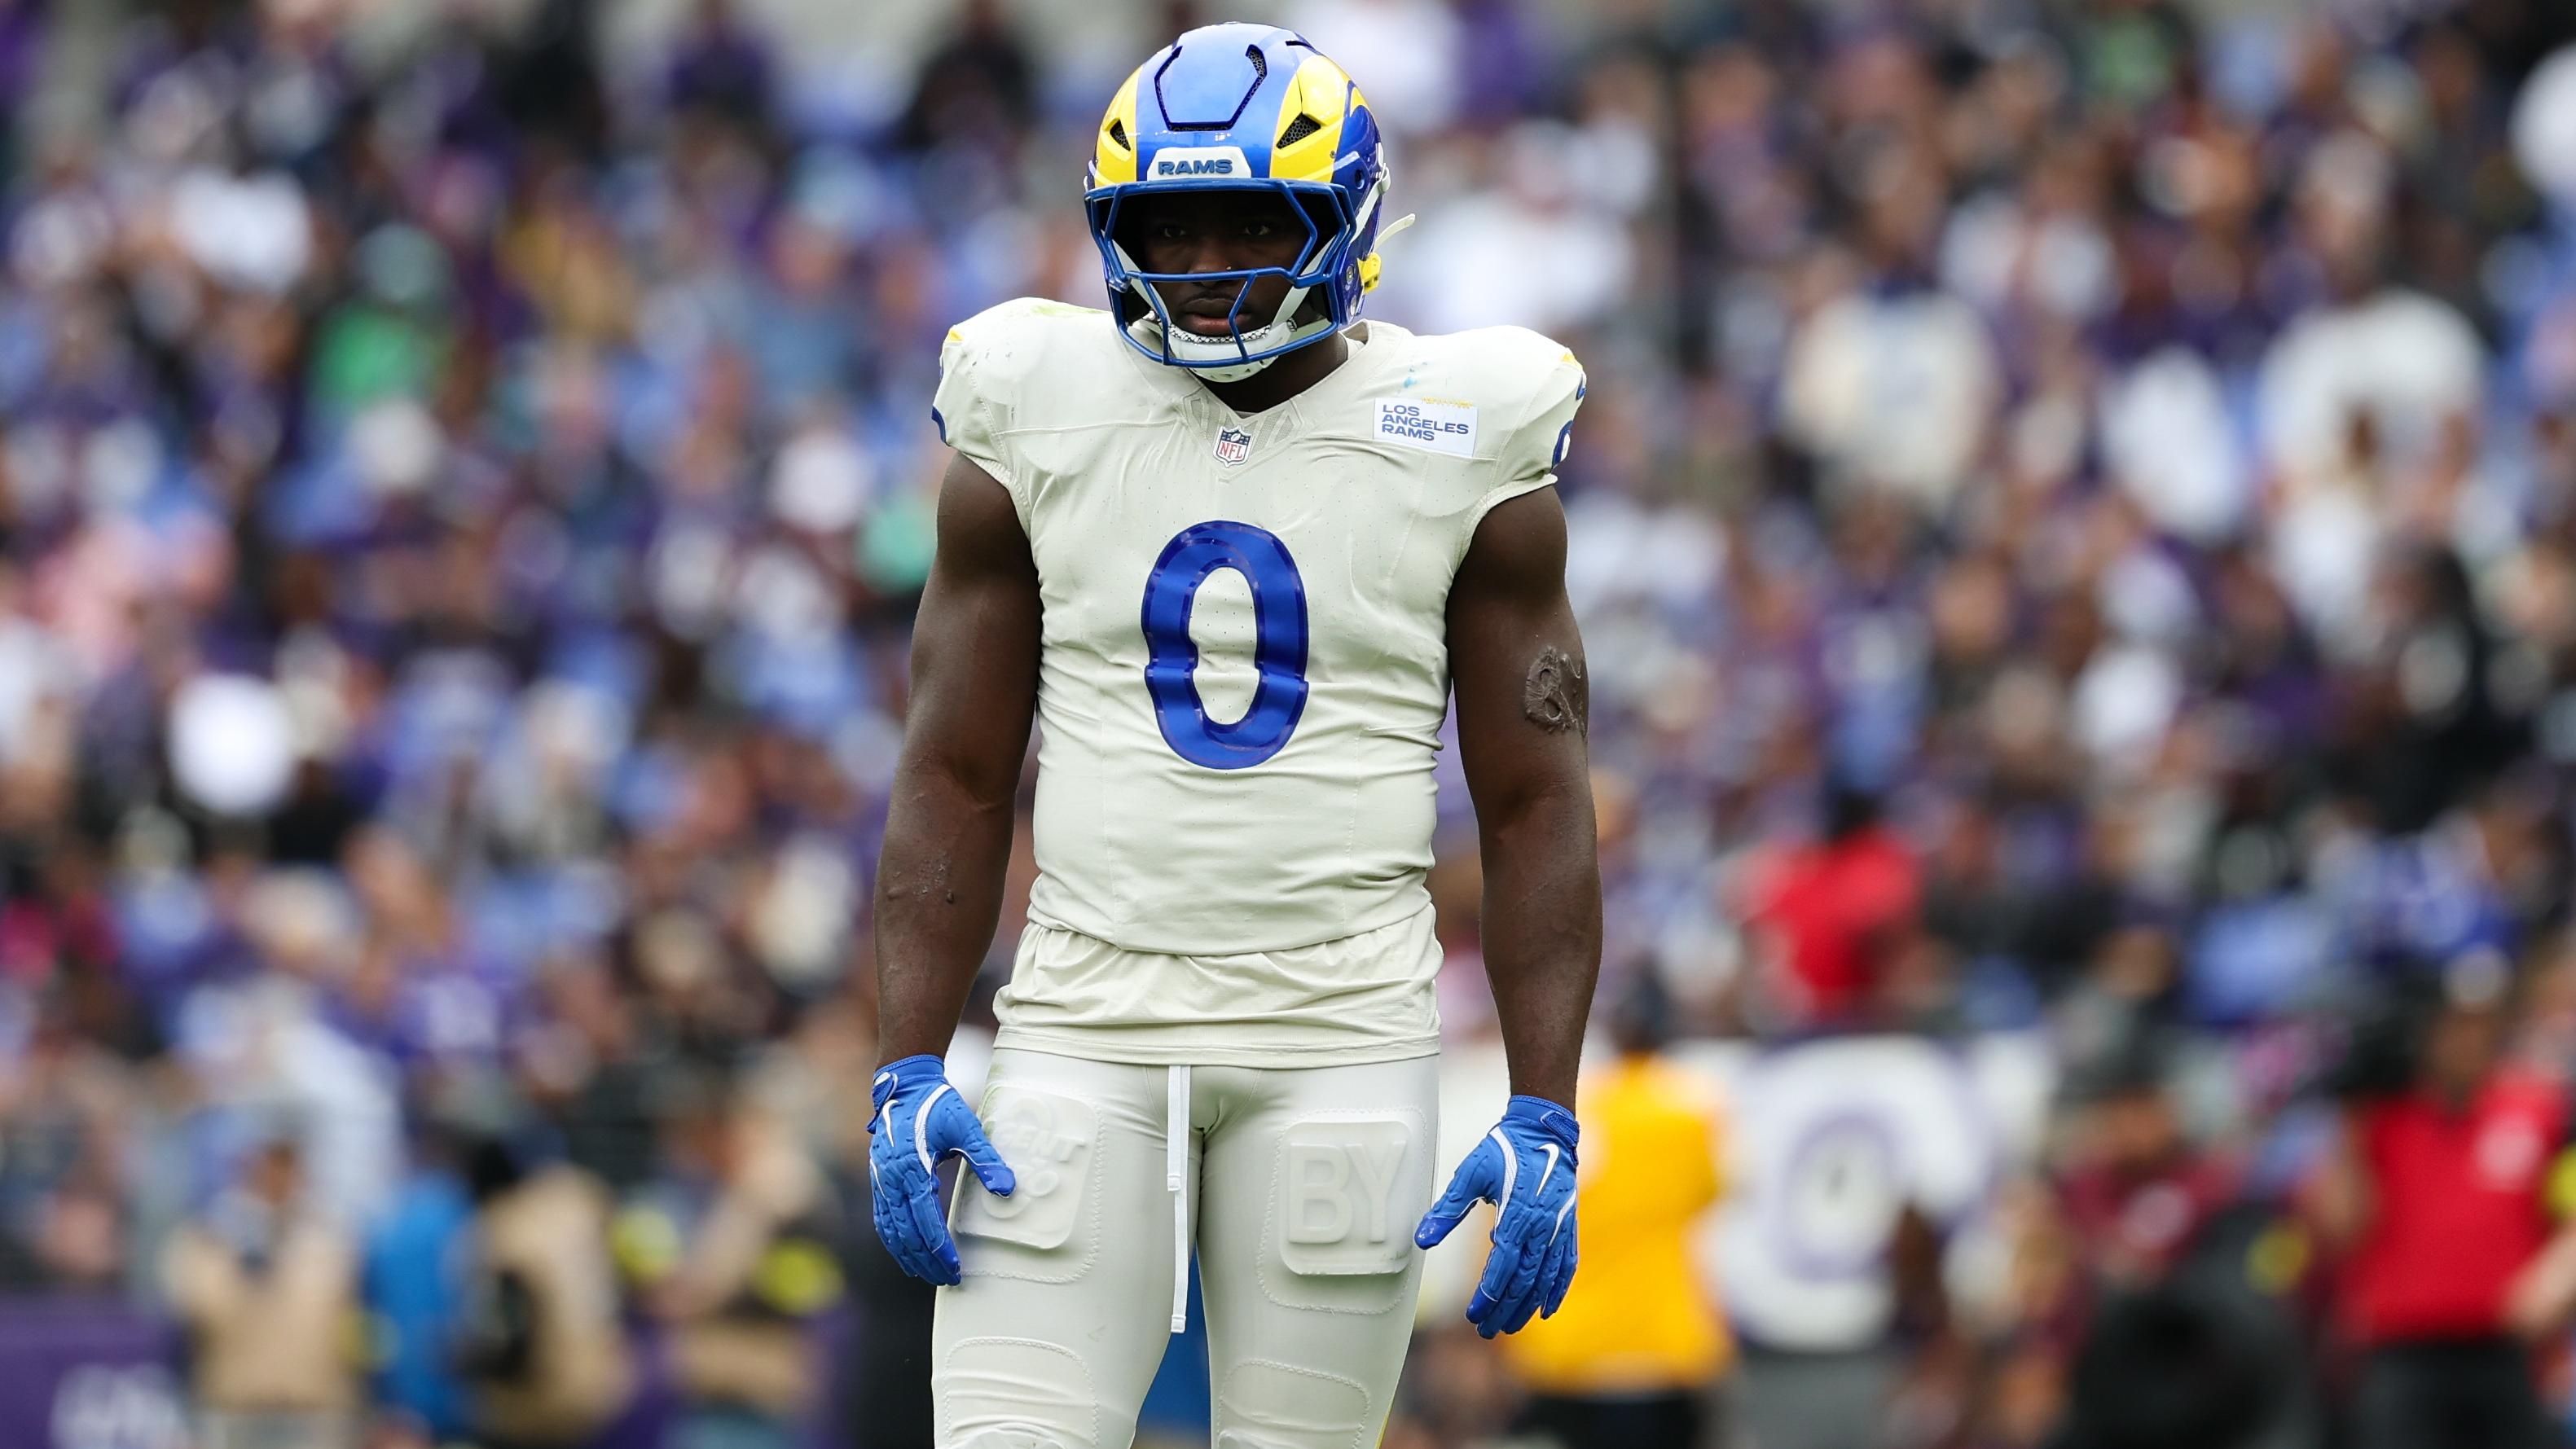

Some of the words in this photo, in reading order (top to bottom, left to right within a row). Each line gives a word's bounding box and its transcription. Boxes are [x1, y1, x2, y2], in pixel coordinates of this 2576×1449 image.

[1158, 159, 1233, 175] RAMS
[1383, 404, 1420, 416] LOS
[1382, 414, 1469, 435] ANGELES
[1382, 424, 1435, 441] RAMS
[1219, 441, 1243, 459] NFL
[1141, 520, 1309, 770] 0
[1289, 1140, 1407, 1245] BY
